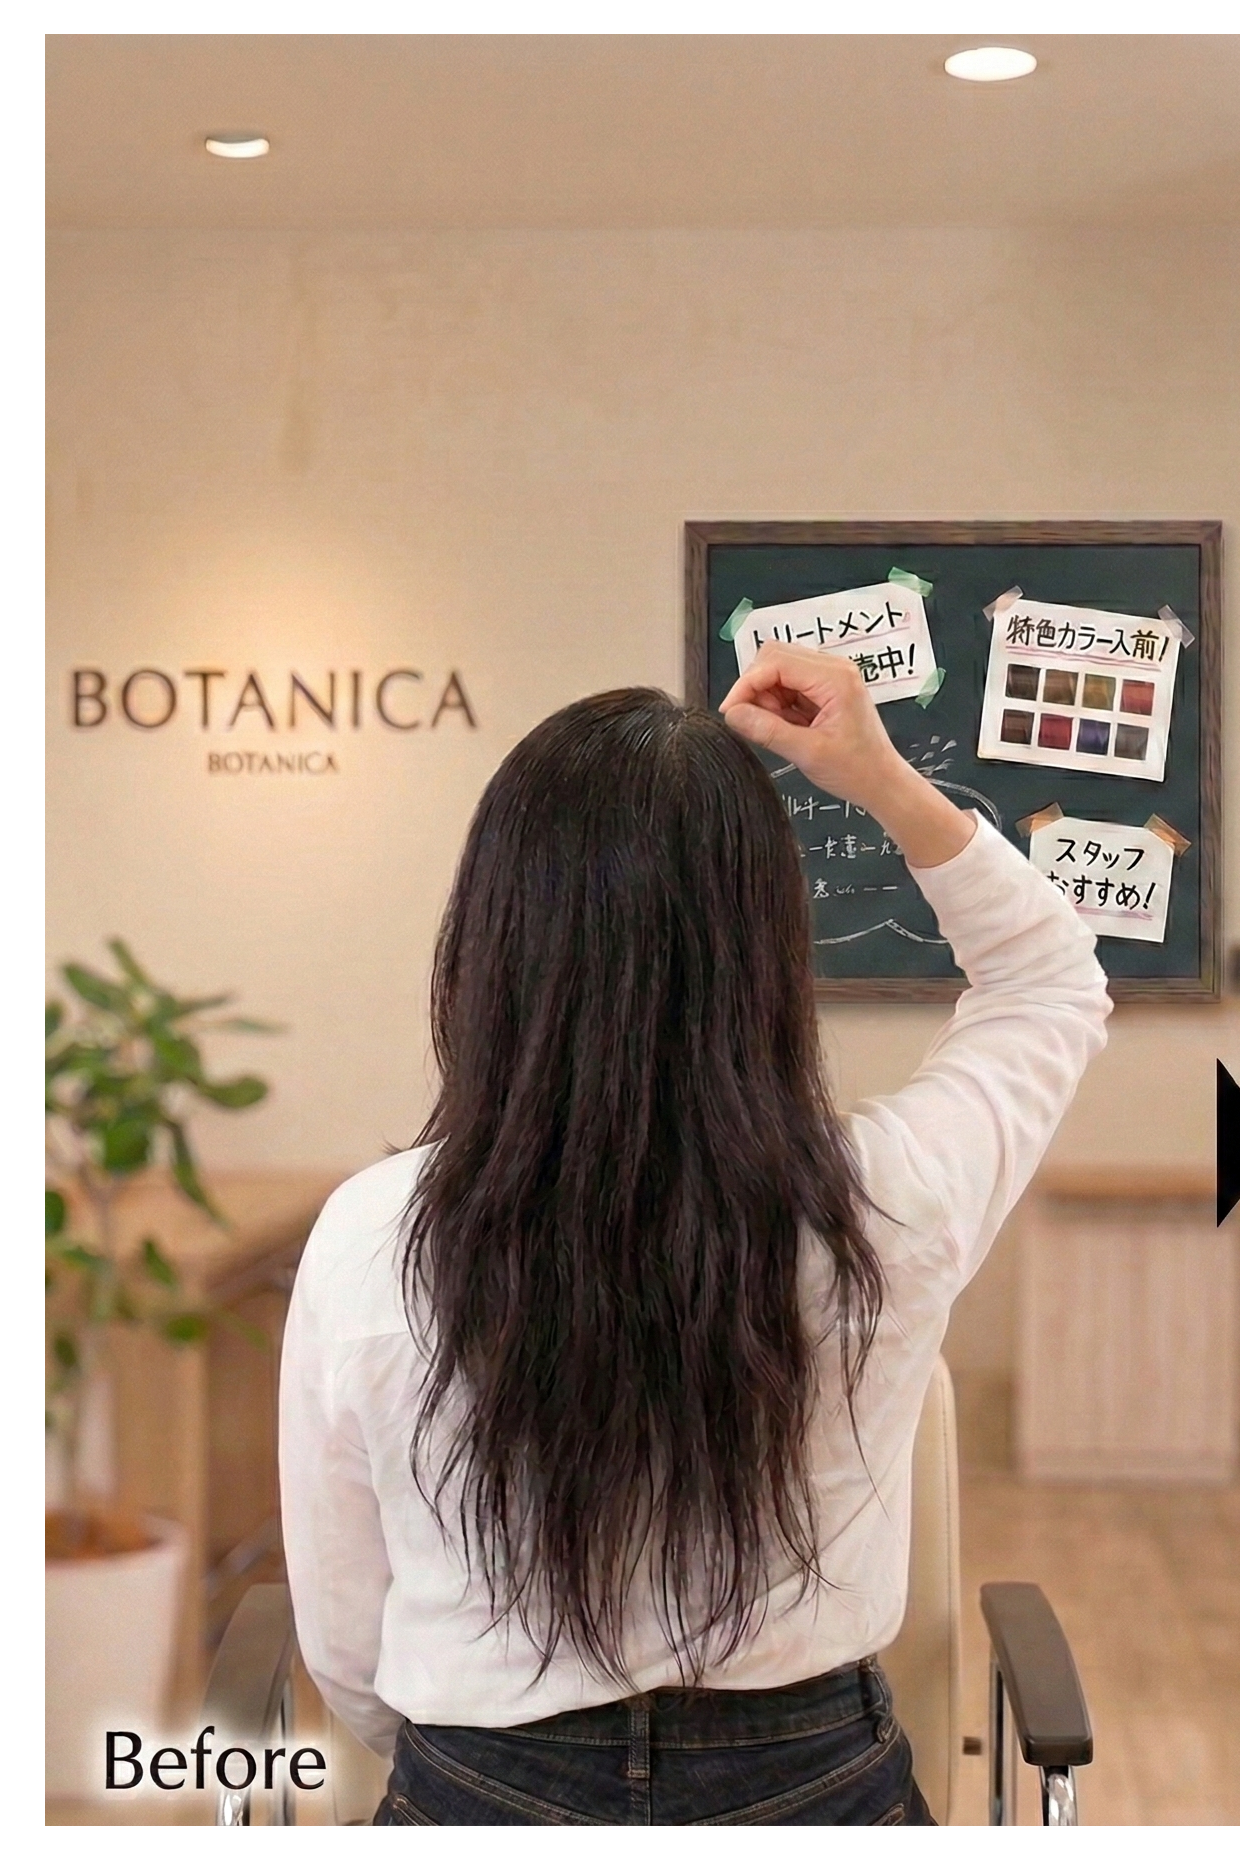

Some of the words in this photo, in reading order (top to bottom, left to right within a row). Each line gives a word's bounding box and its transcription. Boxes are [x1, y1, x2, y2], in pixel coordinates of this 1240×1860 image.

[753, 601, 903, 651] トリートメント
[849, 643, 915, 684] 売中!
[70, 669, 478, 730] BOTANICA
[208, 751, 339, 774] BOTANICA
[1055, 838, 1145, 871] スタッフ
